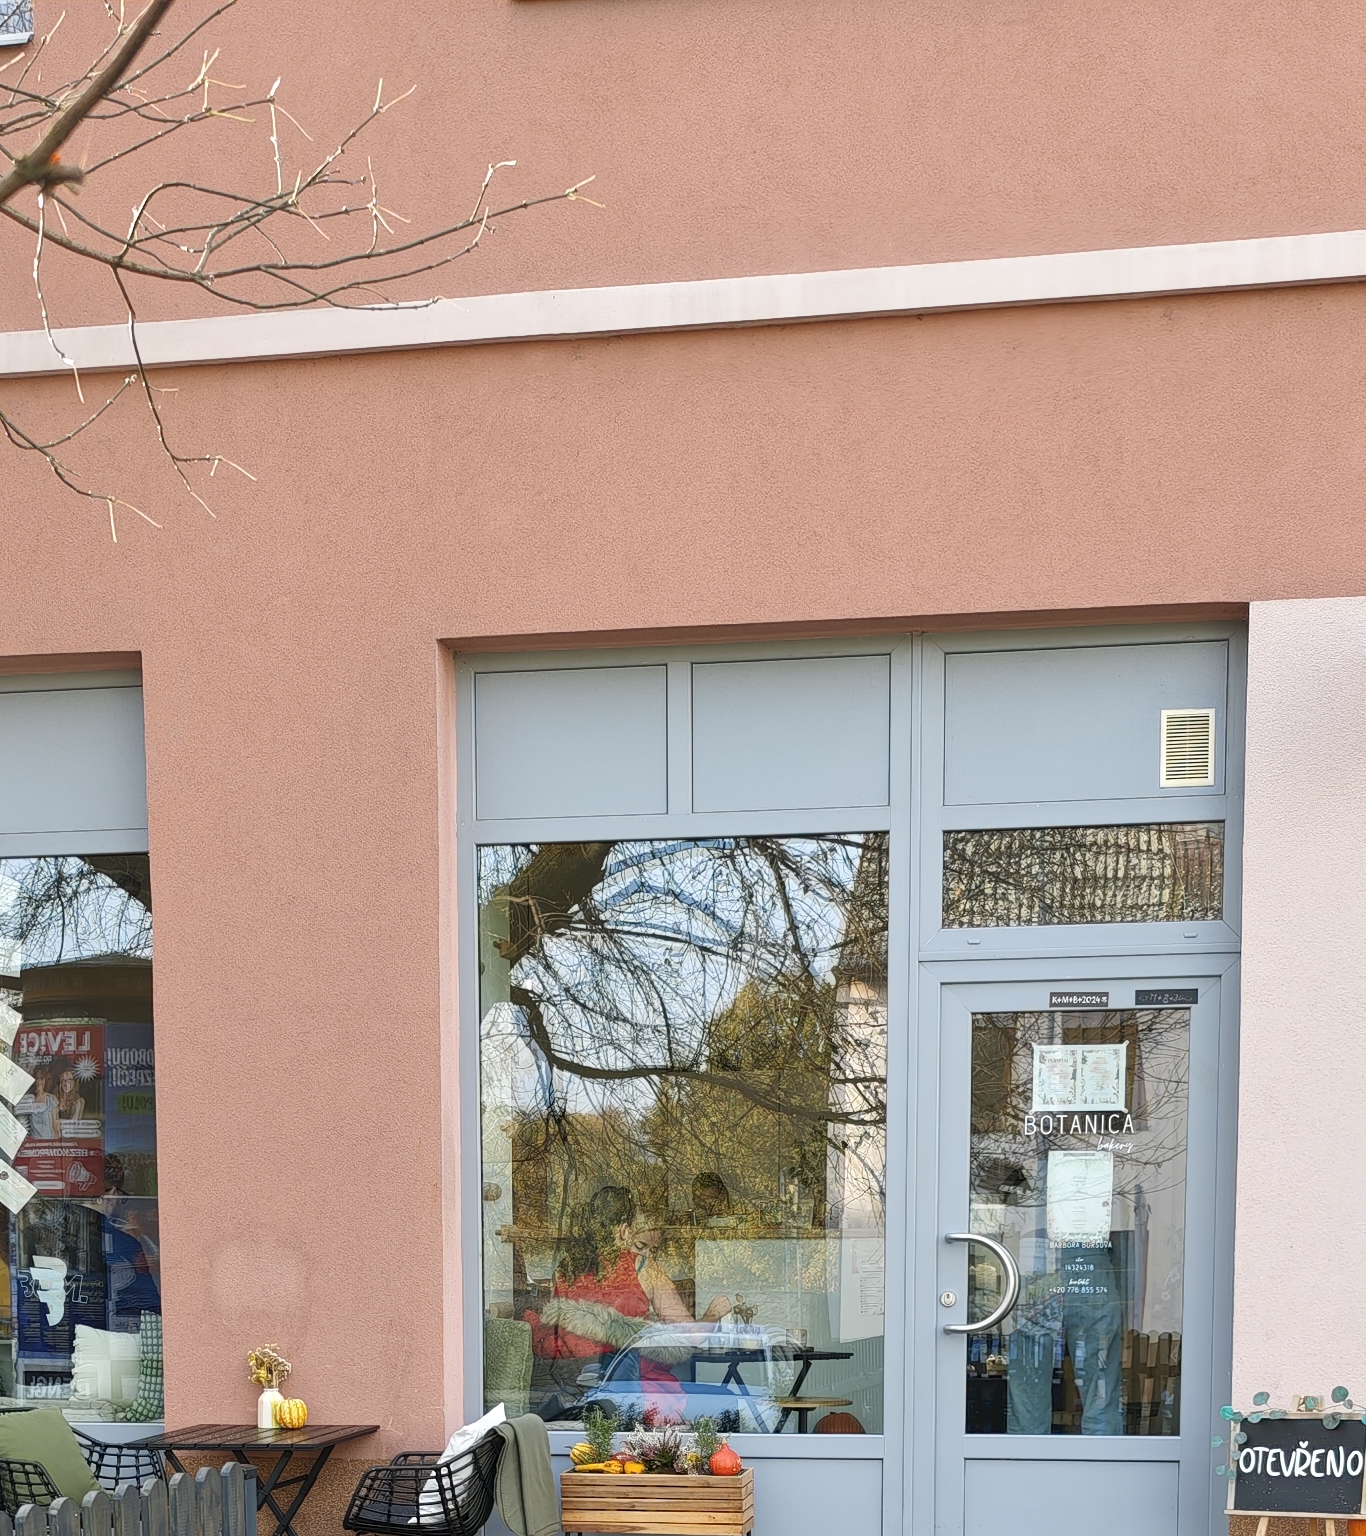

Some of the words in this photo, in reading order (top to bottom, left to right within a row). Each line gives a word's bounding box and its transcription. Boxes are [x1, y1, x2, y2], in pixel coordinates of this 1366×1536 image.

[1025, 1114, 1134, 1135] BOTANICA
[1097, 1136, 1134, 1153] bakery
[1067, 1286, 1079, 1294] 776
[1081, 1286, 1095, 1294] 855
[1095, 1286, 1108, 1294] 574
[1239, 1441, 1363, 1478] OTEVŘENO
